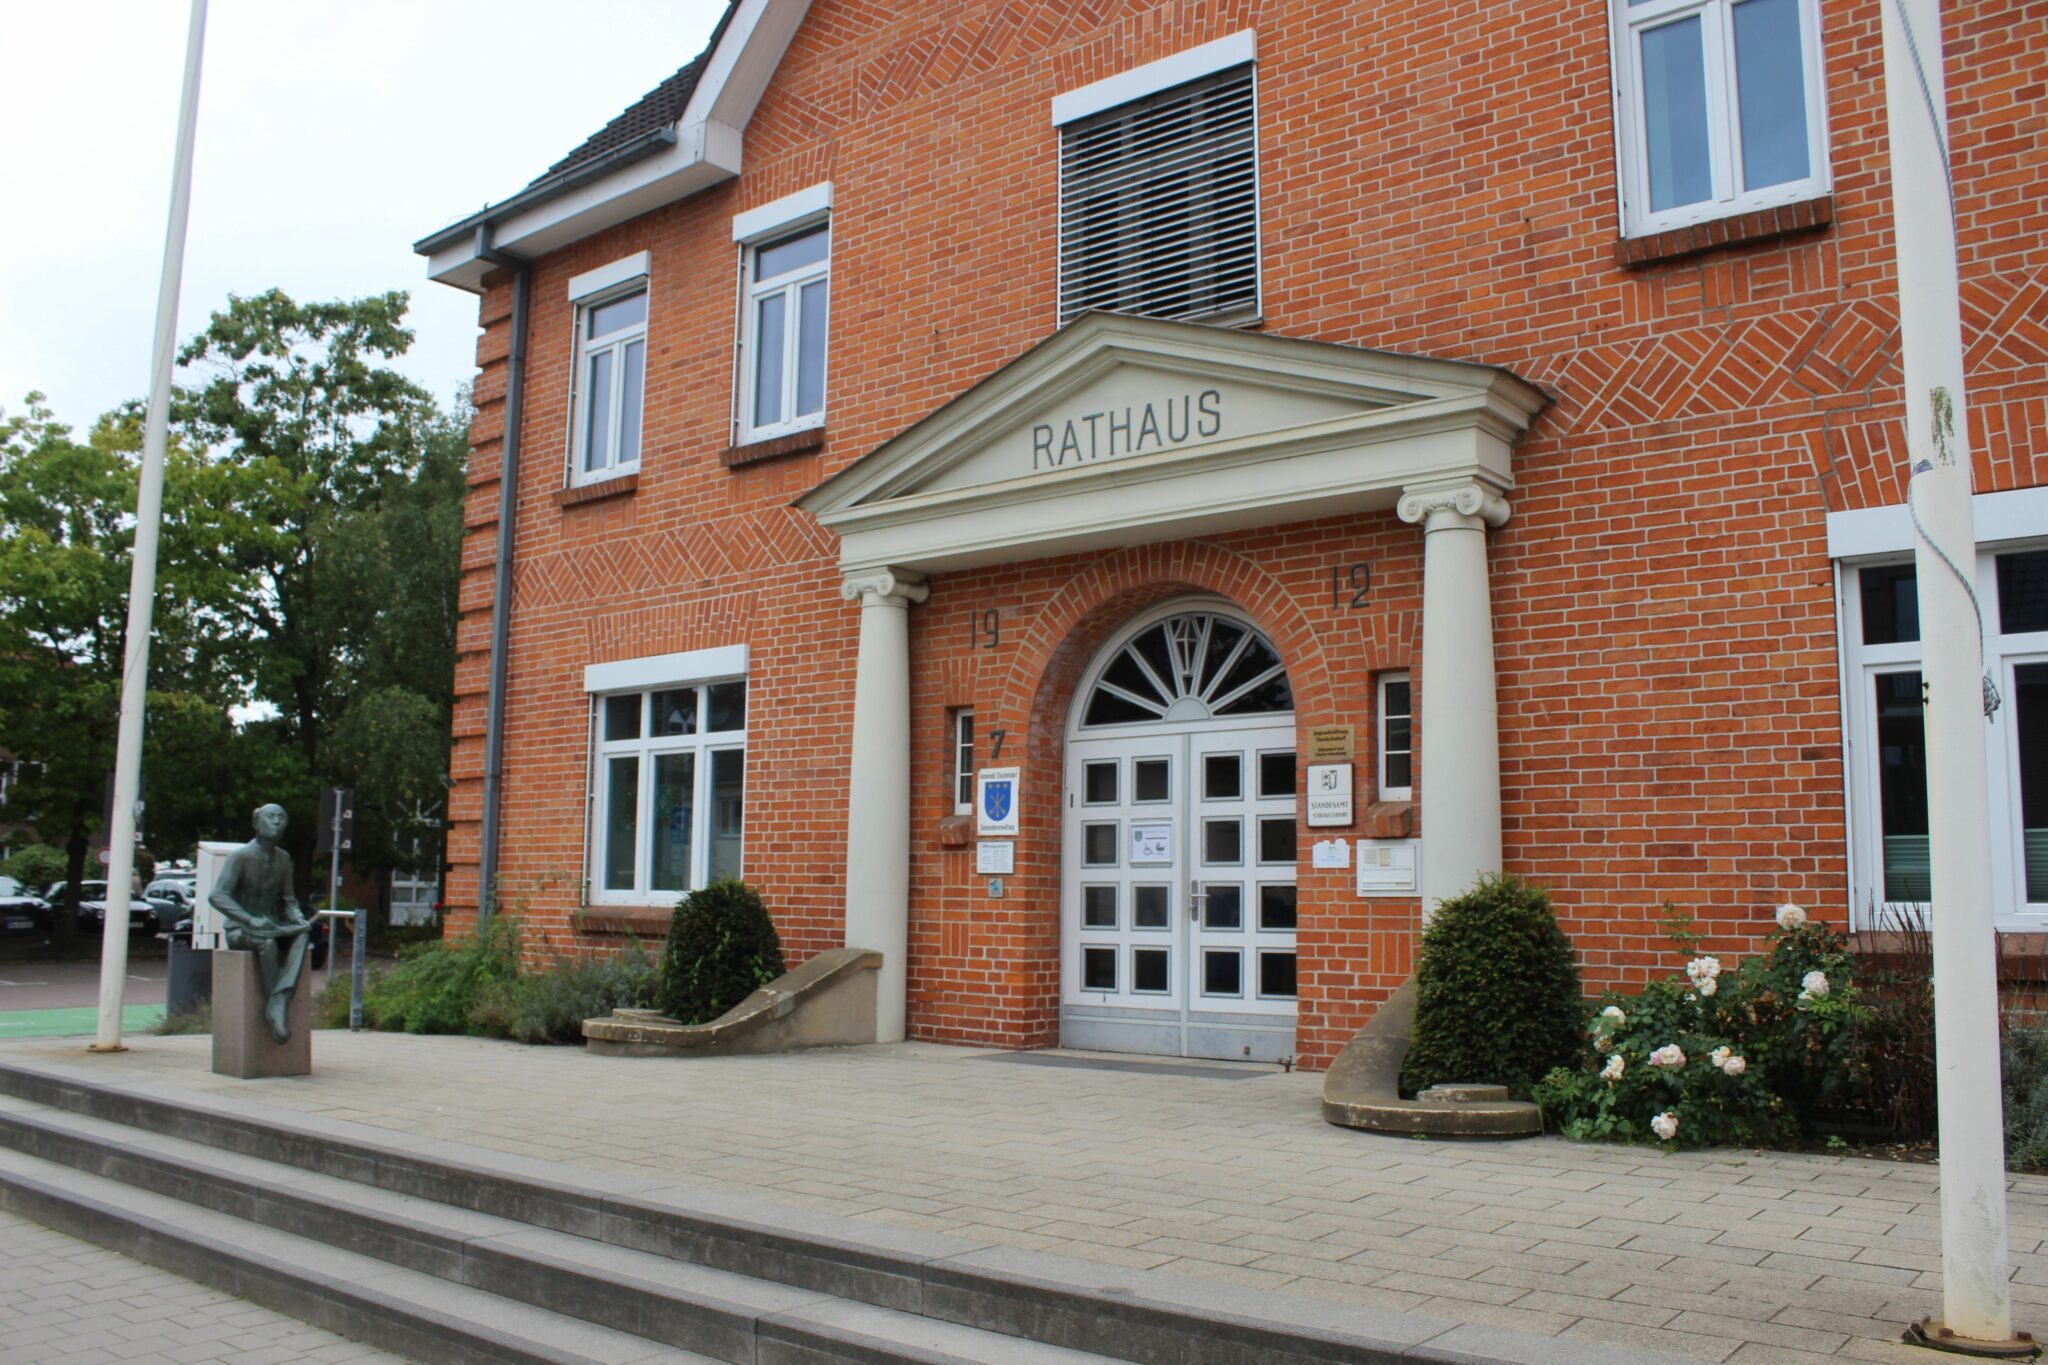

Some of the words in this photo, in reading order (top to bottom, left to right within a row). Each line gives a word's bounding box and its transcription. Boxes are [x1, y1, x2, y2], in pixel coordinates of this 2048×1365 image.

[1033, 389, 1220, 470] RATHAUS
[1332, 561, 1371, 609] 12
[970, 608, 1000, 650] 19
[989, 730, 1006, 759] 7
[1312, 801, 1349, 809] STANDESAMT
